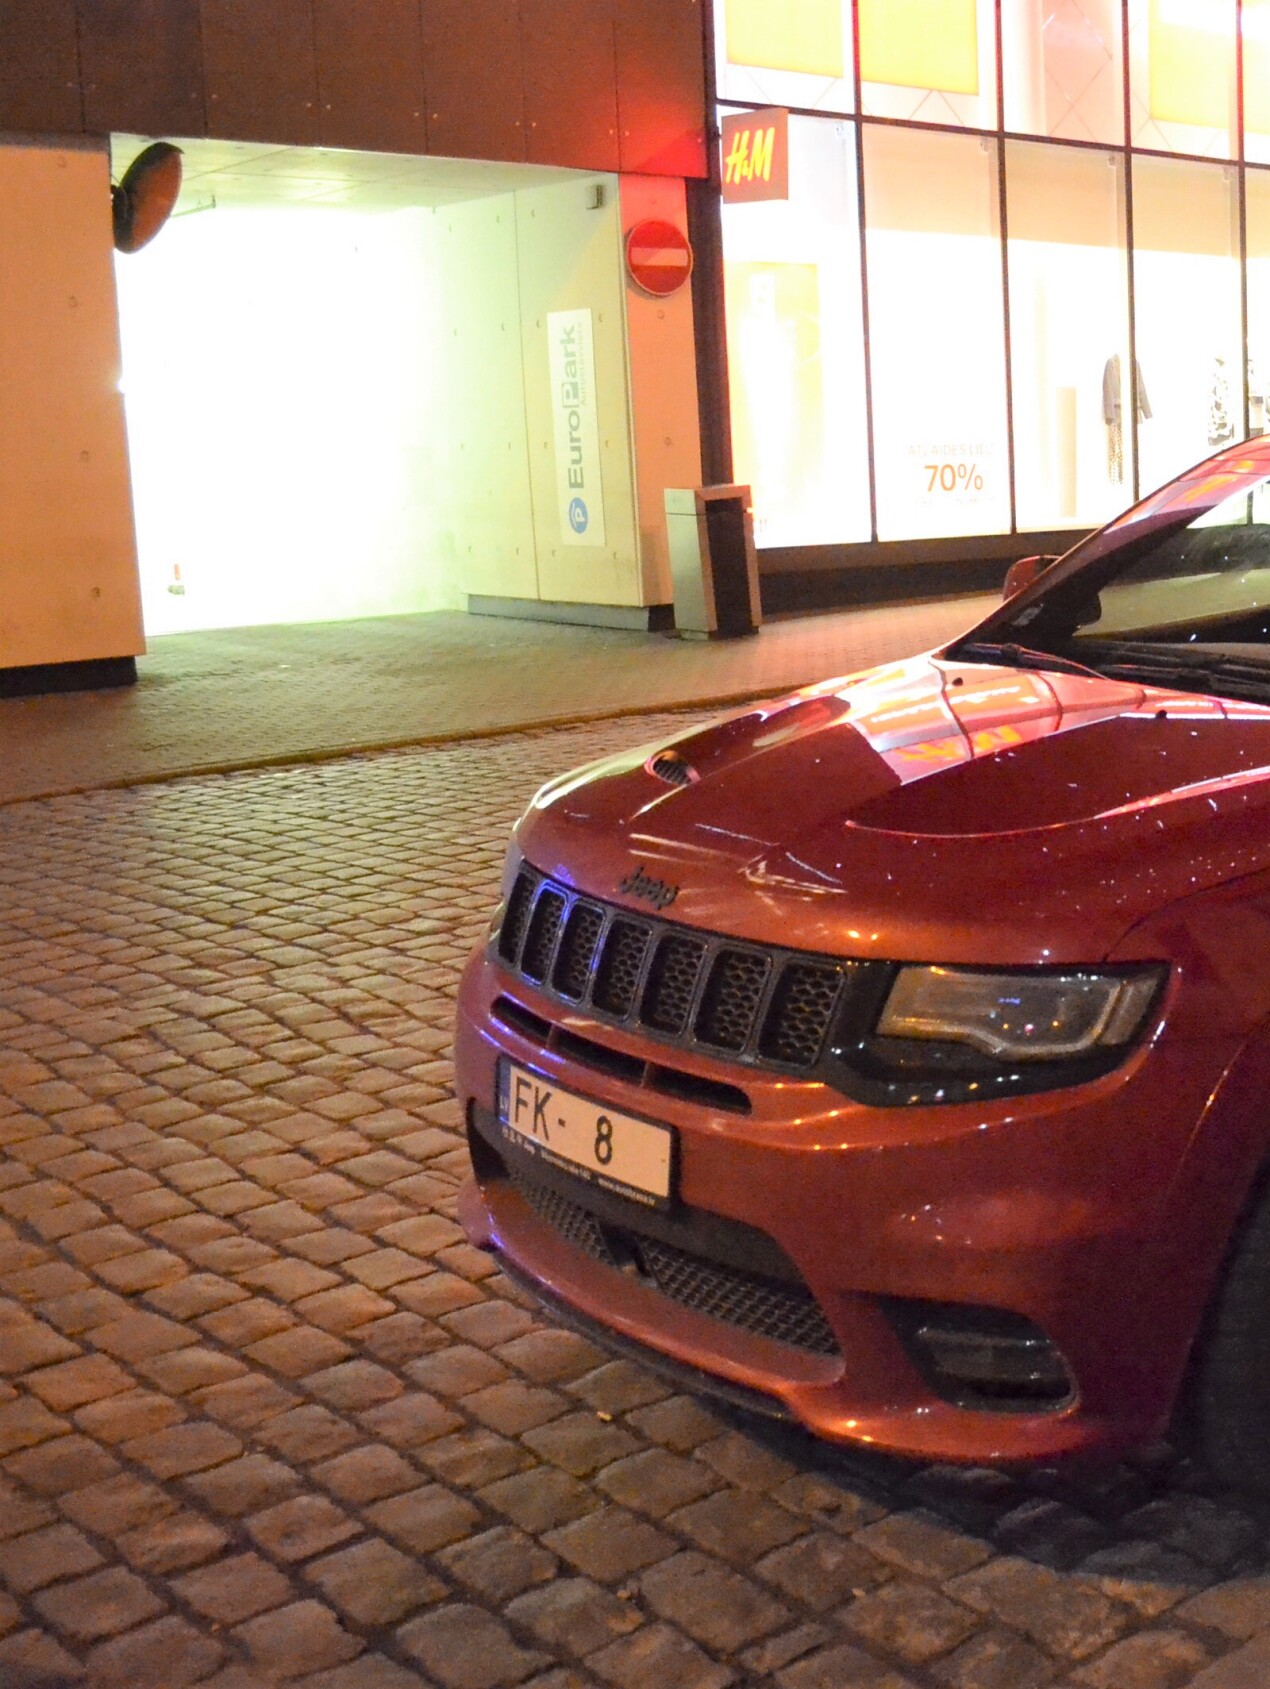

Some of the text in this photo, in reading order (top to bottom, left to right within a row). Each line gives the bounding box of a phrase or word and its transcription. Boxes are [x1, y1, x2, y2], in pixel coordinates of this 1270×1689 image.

[725, 127, 775, 185] H&M
[561, 324, 584, 489] EuroPark
[924, 463, 984, 492] 70%
[620, 866, 681, 911] Jeep
[594, 1115, 614, 1166] 8
